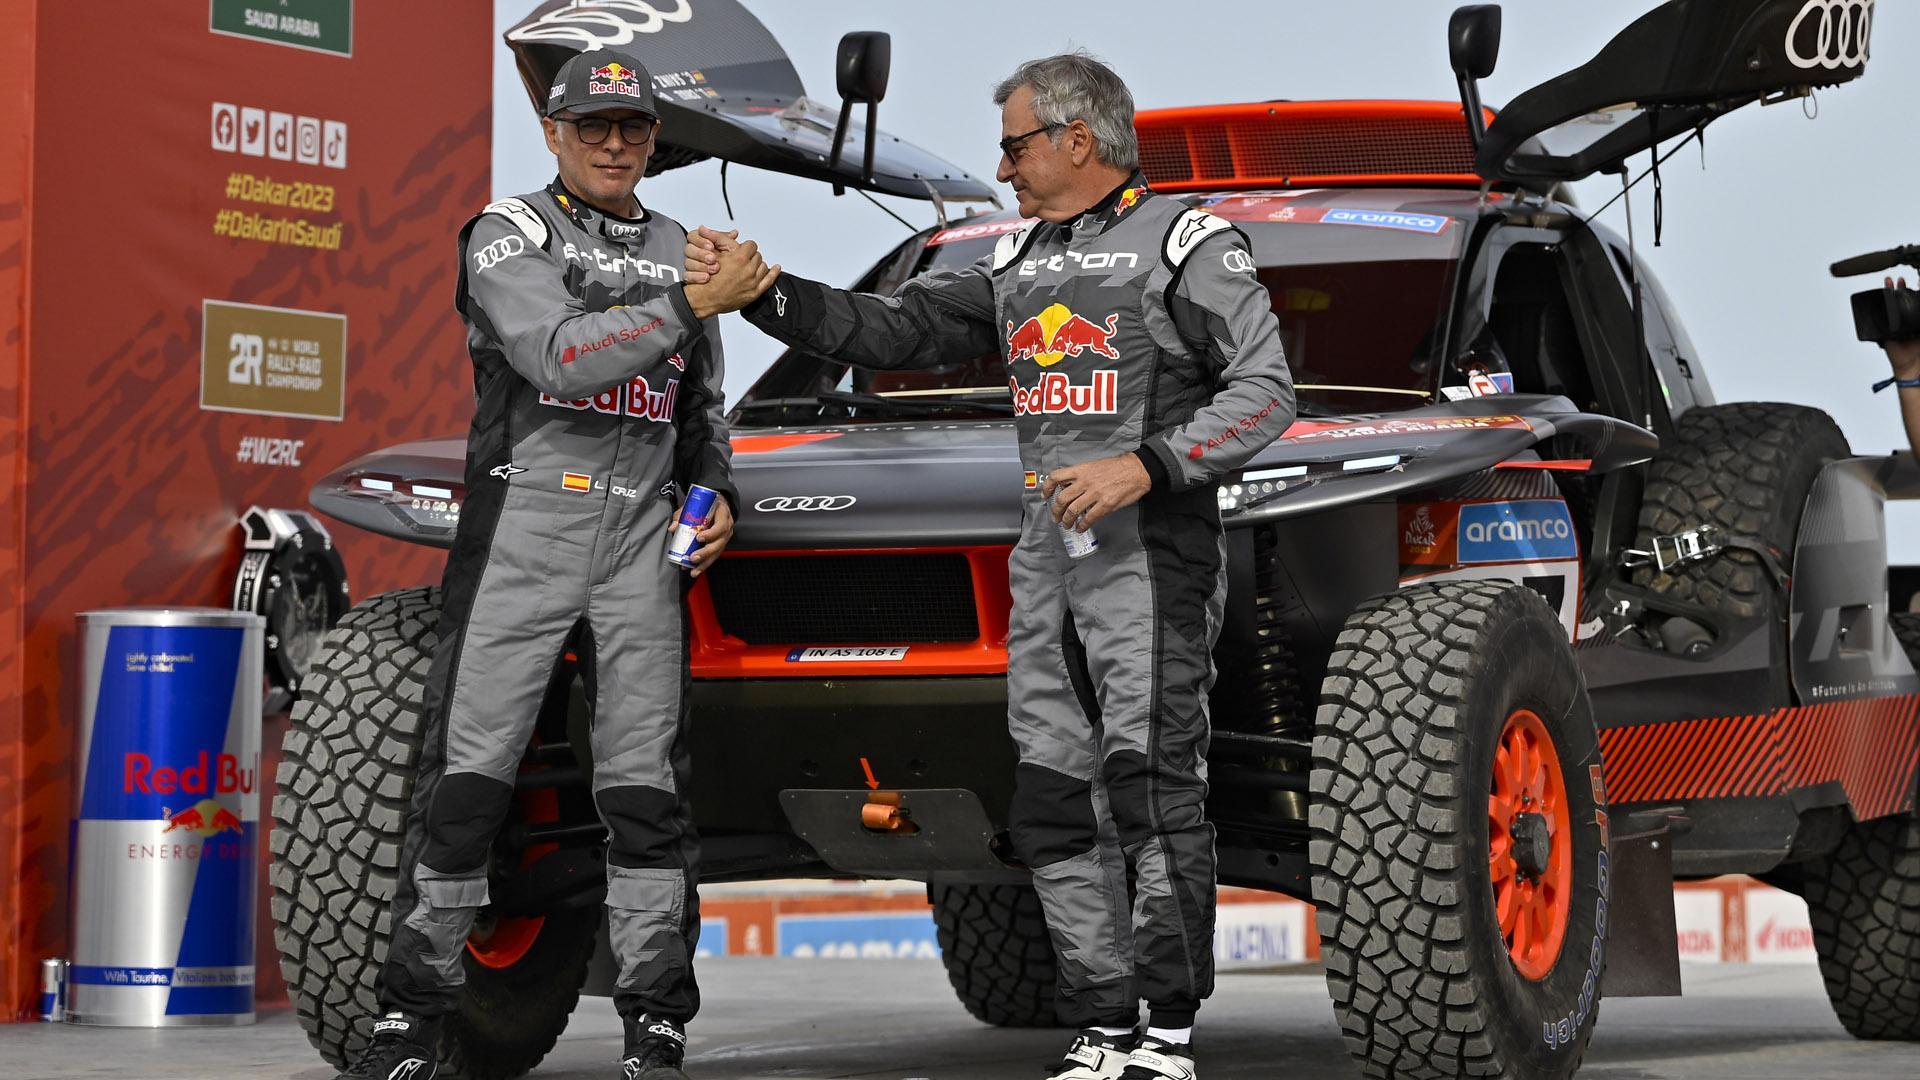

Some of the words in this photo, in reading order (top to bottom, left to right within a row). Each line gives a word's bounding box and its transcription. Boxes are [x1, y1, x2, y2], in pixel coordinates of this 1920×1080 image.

[245, 8, 278, 31] SAUDI
[280, 14, 320, 39] ARABIA
[590, 80, 616, 95] Red
[617, 81, 640, 98] Bull
[225, 172, 334, 212] #Dakar2023
[1332, 212, 1436, 227] aramco
[562, 242, 680, 283] e-tron
[1018, 250, 1139, 276] e-tron
[581, 333, 616, 355] Audi
[619, 316, 664, 341] Sport
[625, 375, 679, 422] Bull
[1043, 370, 1118, 415] Bull
[1207, 424, 1239, 451] Audi
[1240, 398, 1280, 432] Sport
[236, 437, 304, 467] #W2RC
[1465, 518, 1569, 542] aramco
[808, 648, 828, 657] IN
[830, 648, 852, 657] AS
[855, 648, 887, 657] 108
[889, 648, 903, 657] E
[123, 751, 209, 794] Red
[216, 753, 259, 794] Bul
[127, 843, 213, 860] ENERGY
[104, 970, 128, 983] With
[130, 970, 170, 985] Taurine.
